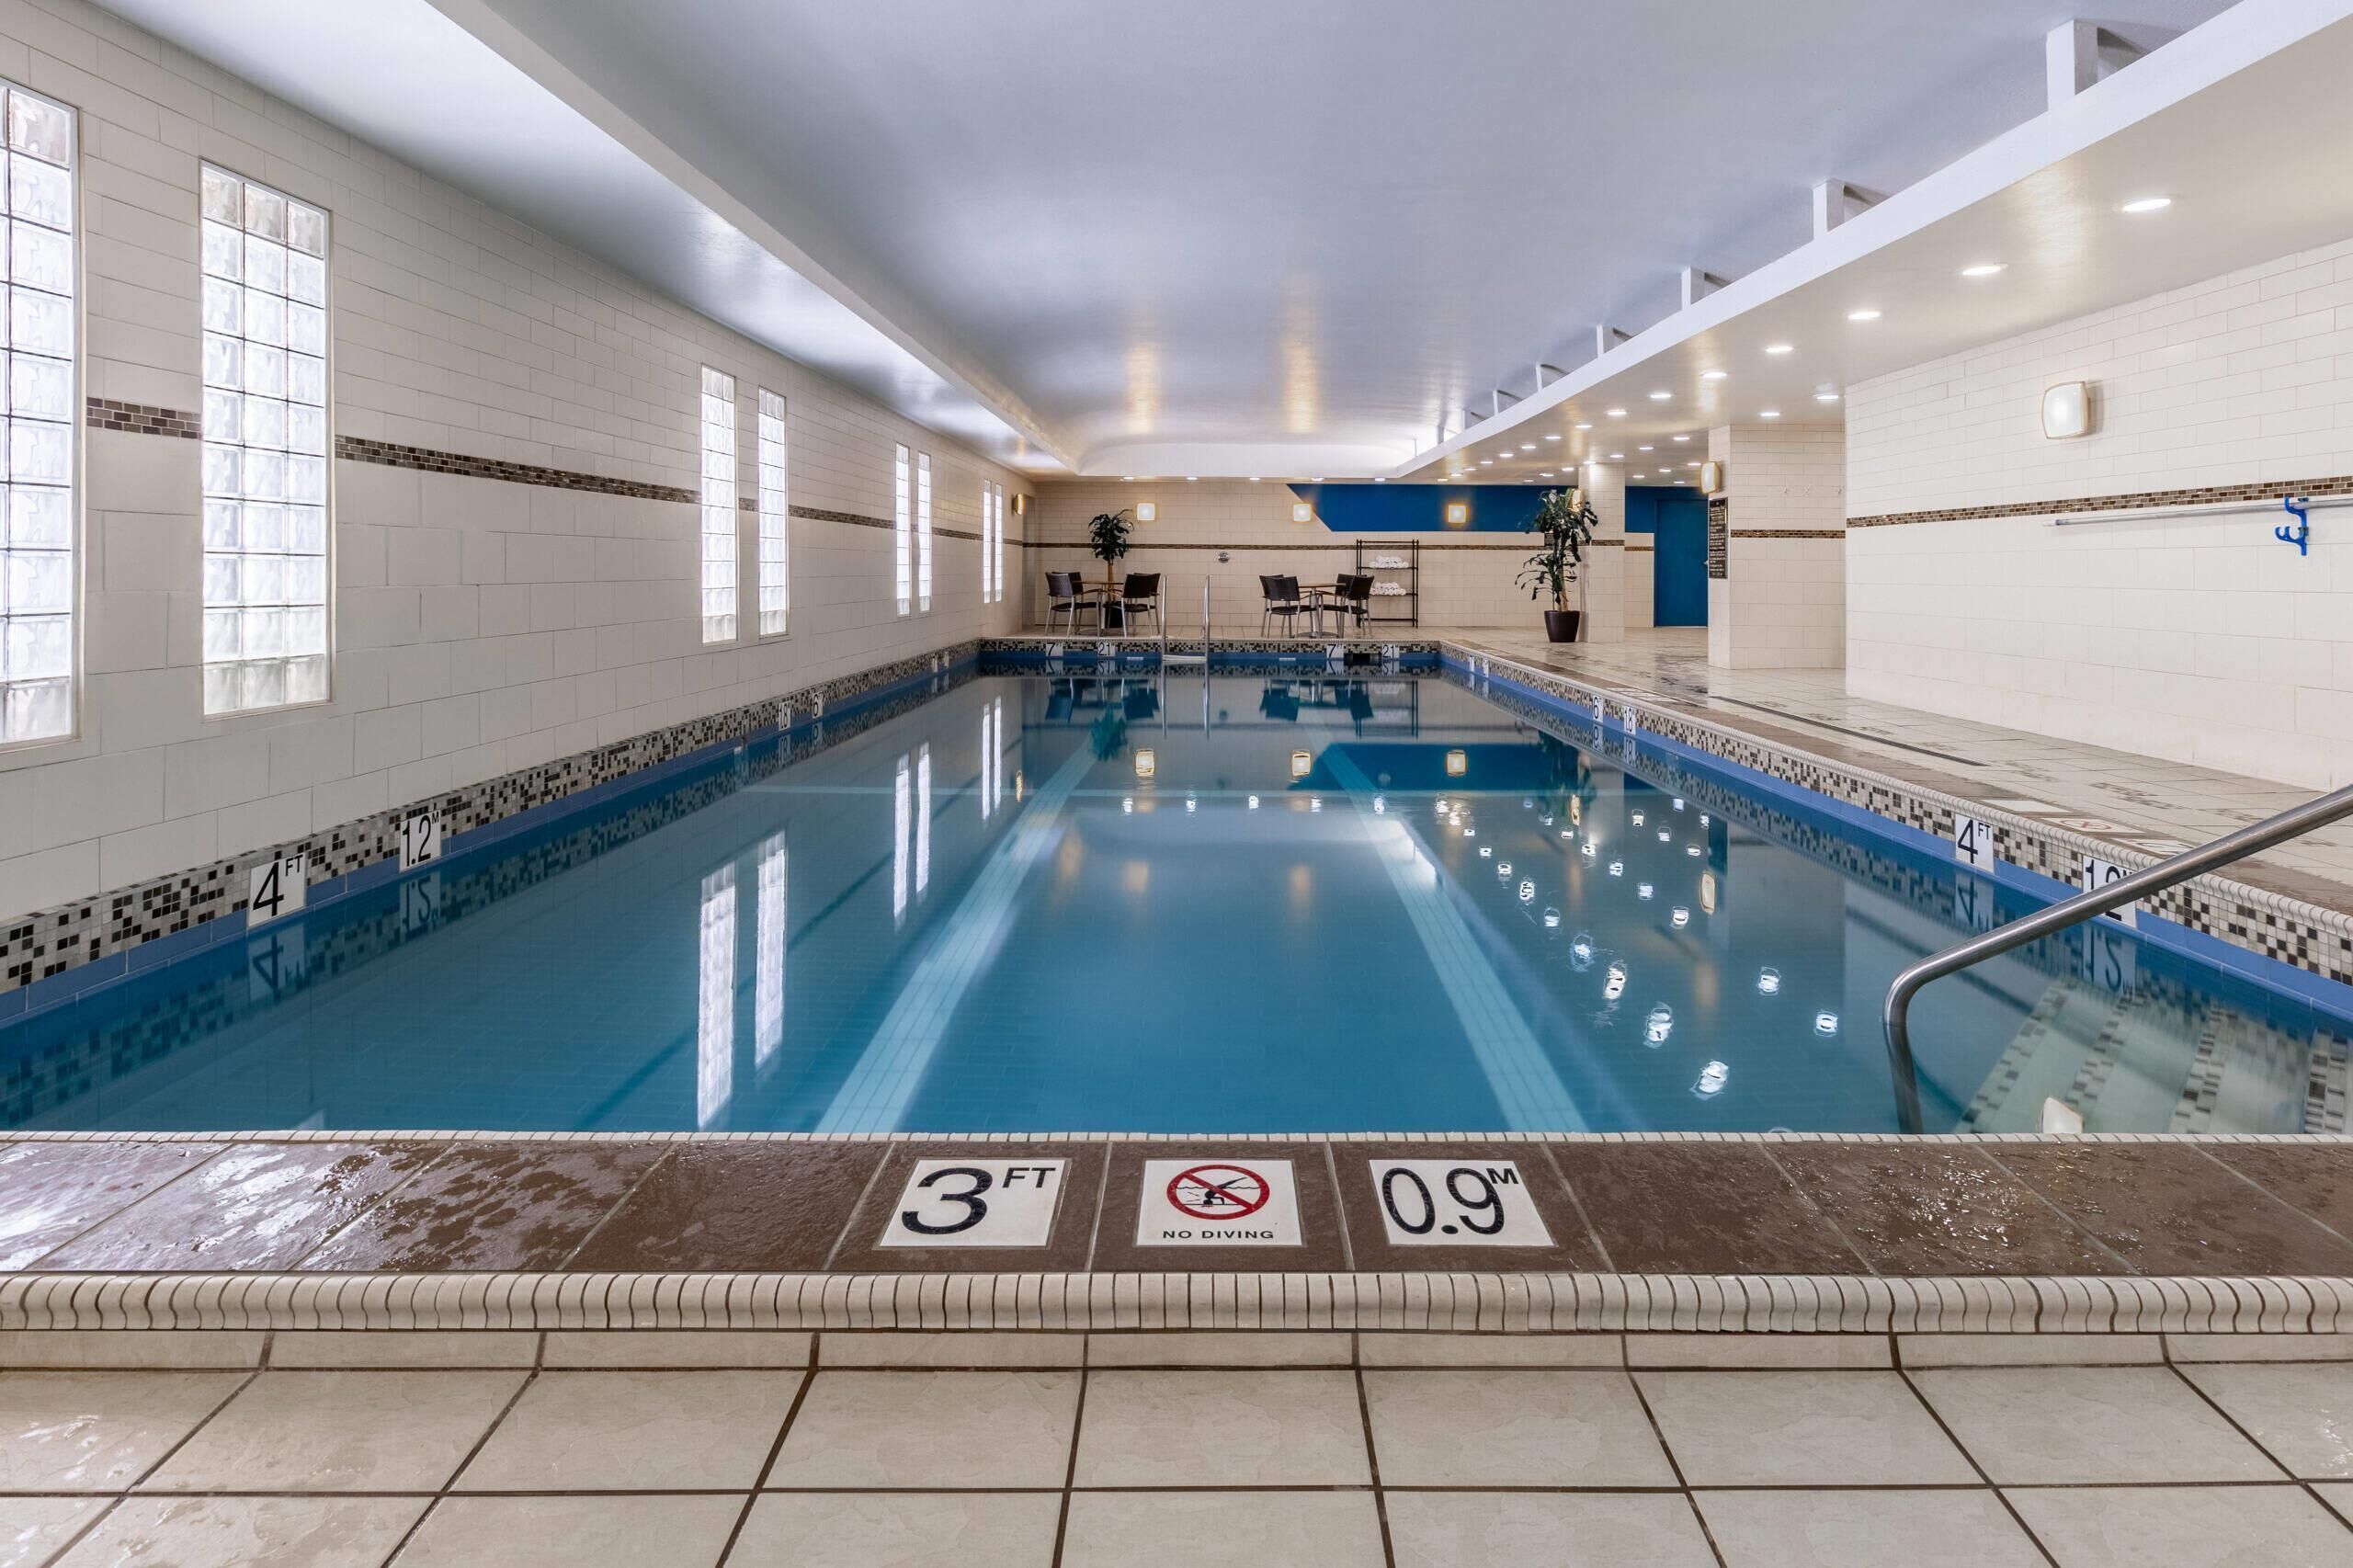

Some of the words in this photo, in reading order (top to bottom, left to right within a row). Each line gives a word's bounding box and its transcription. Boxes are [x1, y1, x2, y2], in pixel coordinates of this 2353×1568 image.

[1047, 642, 1055, 655] 7
[1327, 643, 1336, 658] 7
[813, 693, 818, 717] 6
[1594, 696, 1599, 720] 6
[402, 814, 431, 868] 1.2
[431, 812, 439, 824] M
[1957, 819, 1978, 864] 4
[1977, 822, 1992, 840] FT
[253, 860, 285, 917] 4
[285, 854, 303, 877] FT
[901, 1167, 994, 1235] 3
[1002, 1167, 1057, 1188] FT
[1381, 1167, 1505, 1235] 0.9
[1485, 1167, 1519, 1185] M
[1163, 1230, 1192, 1239] NO
[1201, 1230, 1274, 1239] DIVING
